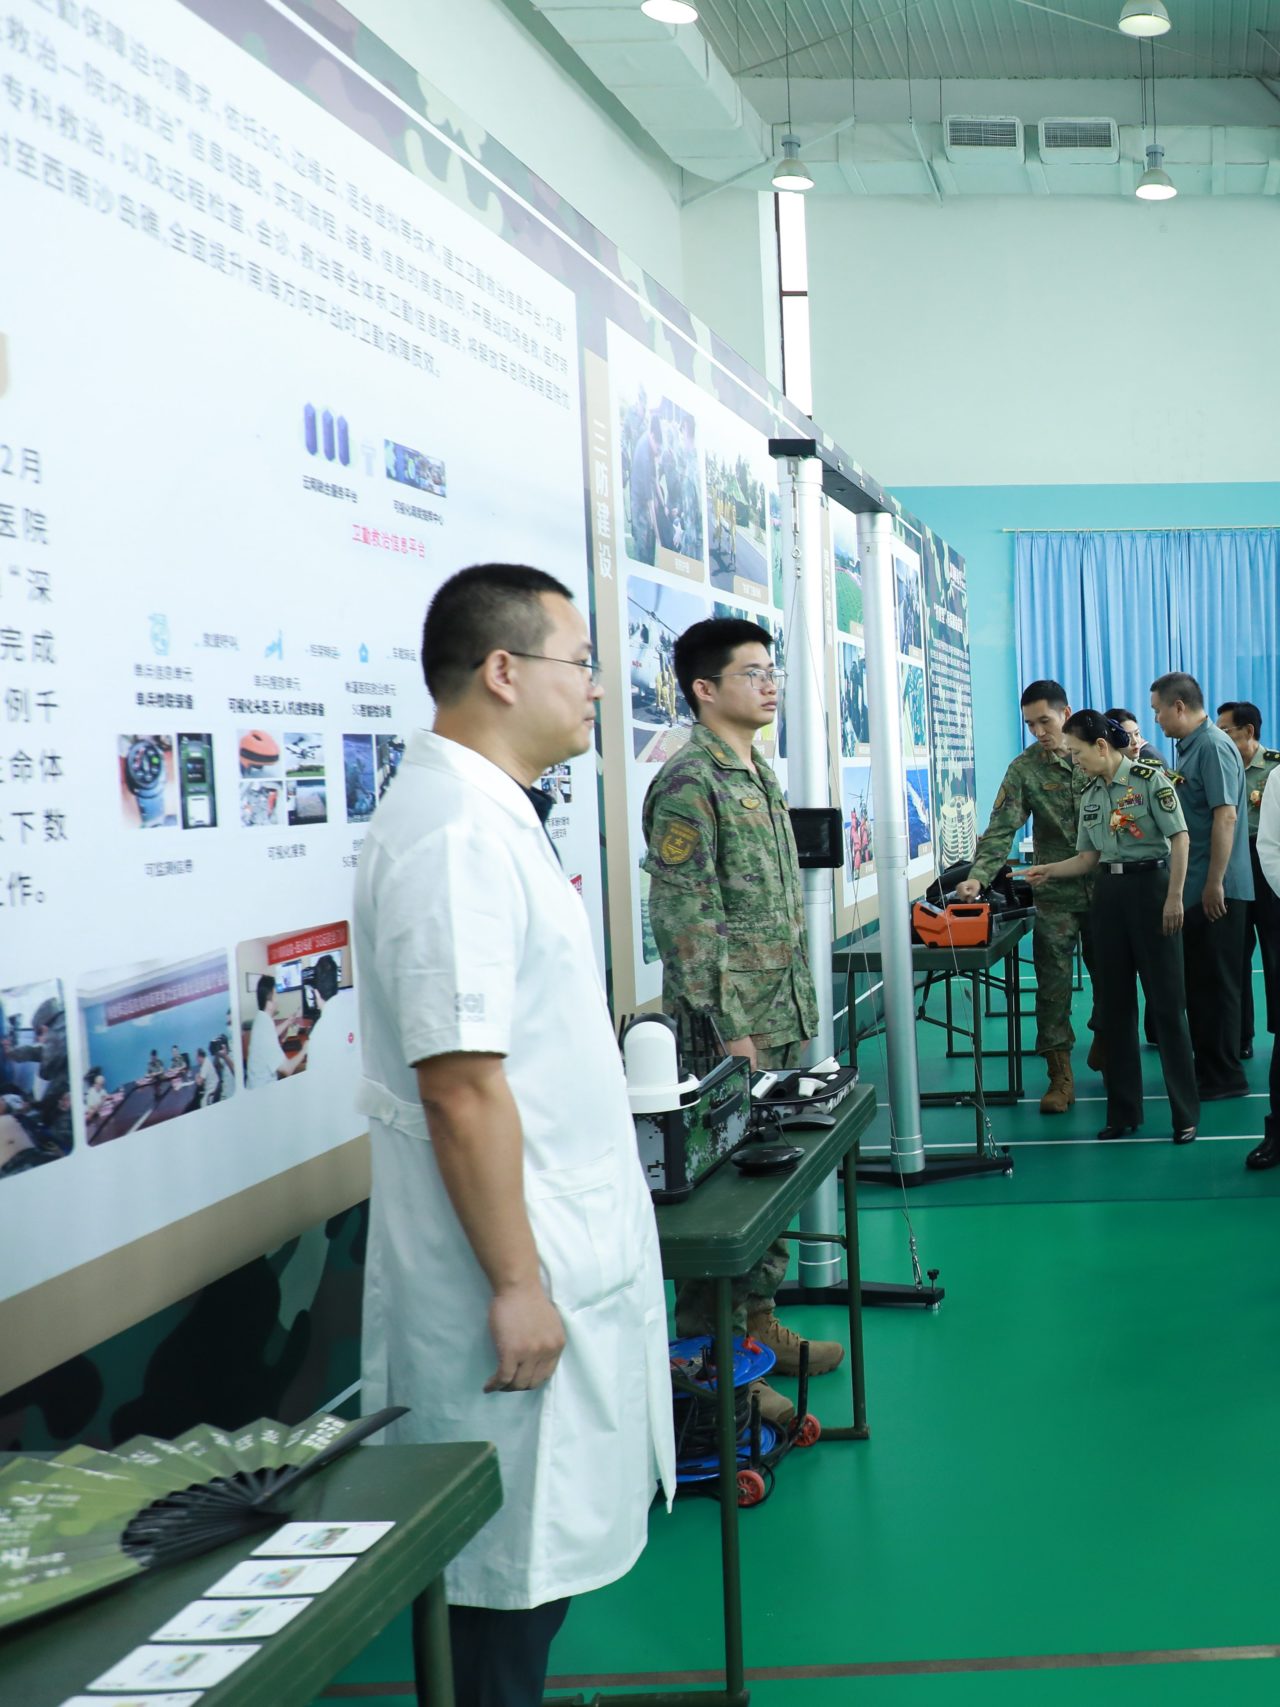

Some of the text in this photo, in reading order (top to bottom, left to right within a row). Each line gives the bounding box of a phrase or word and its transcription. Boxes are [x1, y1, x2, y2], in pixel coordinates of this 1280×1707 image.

[593, 418, 613, 580] 三防建设
[0, 502, 47, 545] 医院
[352, 523, 426, 559] 卫勤救治信息平台
[0, 624, 54, 663] 完成
[6, 687, 58, 722] 例千
[0, 808, 67, 842] 下数
[0, 871, 46, 908] 作。
